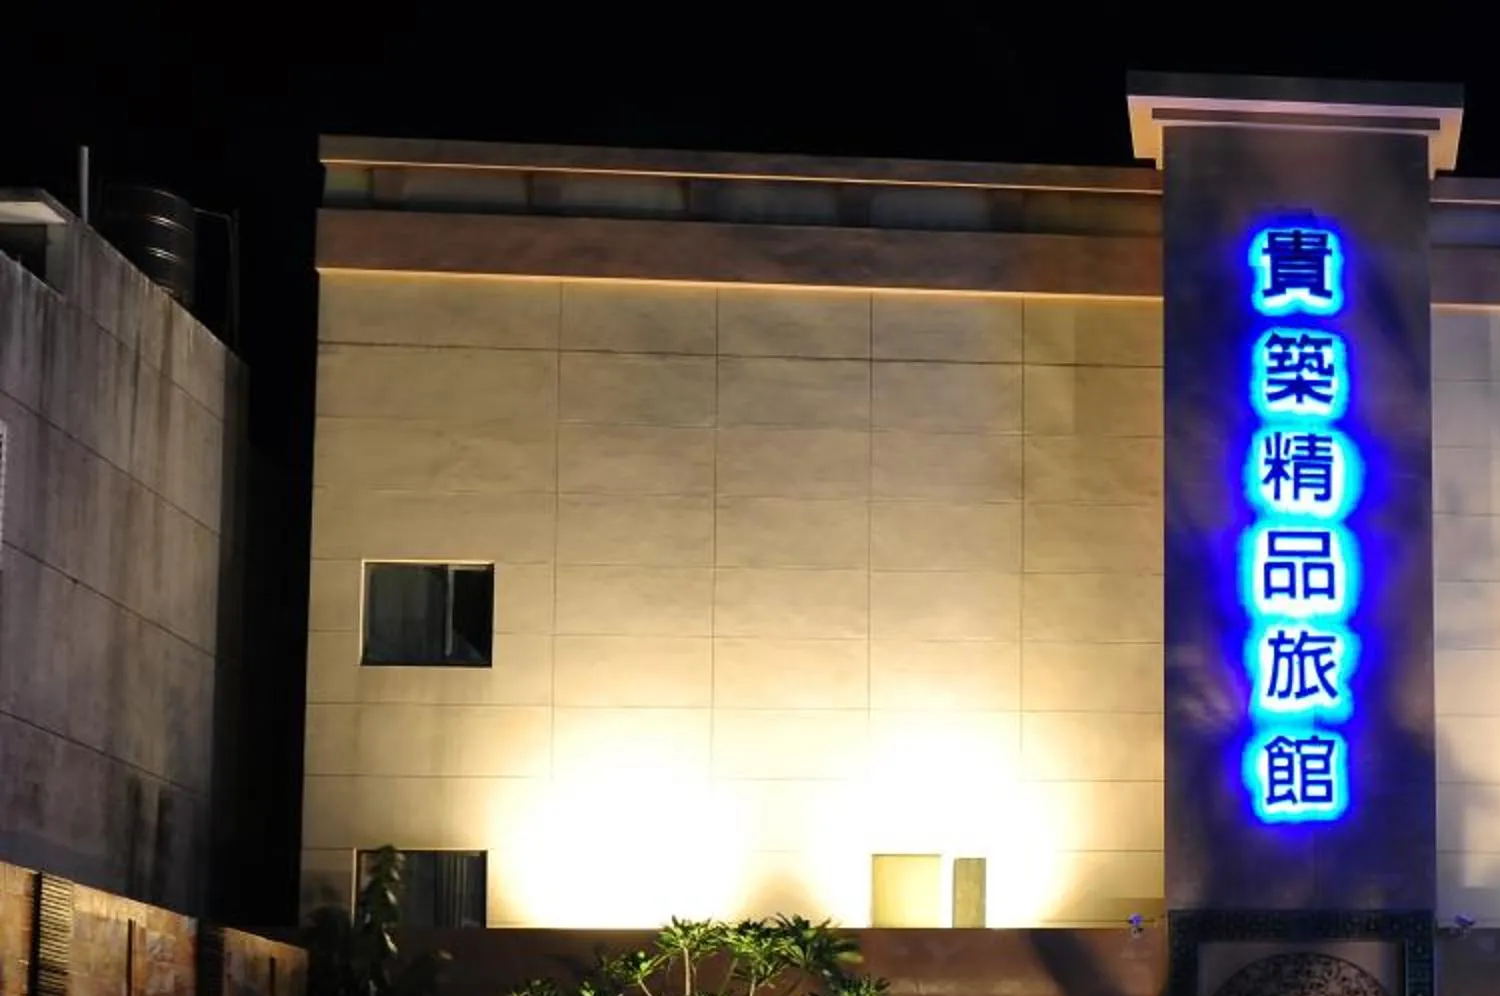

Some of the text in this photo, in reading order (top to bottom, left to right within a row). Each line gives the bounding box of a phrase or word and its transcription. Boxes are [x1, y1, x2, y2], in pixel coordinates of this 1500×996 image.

[1262, 230, 1336, 804] 貴築精品旅館
